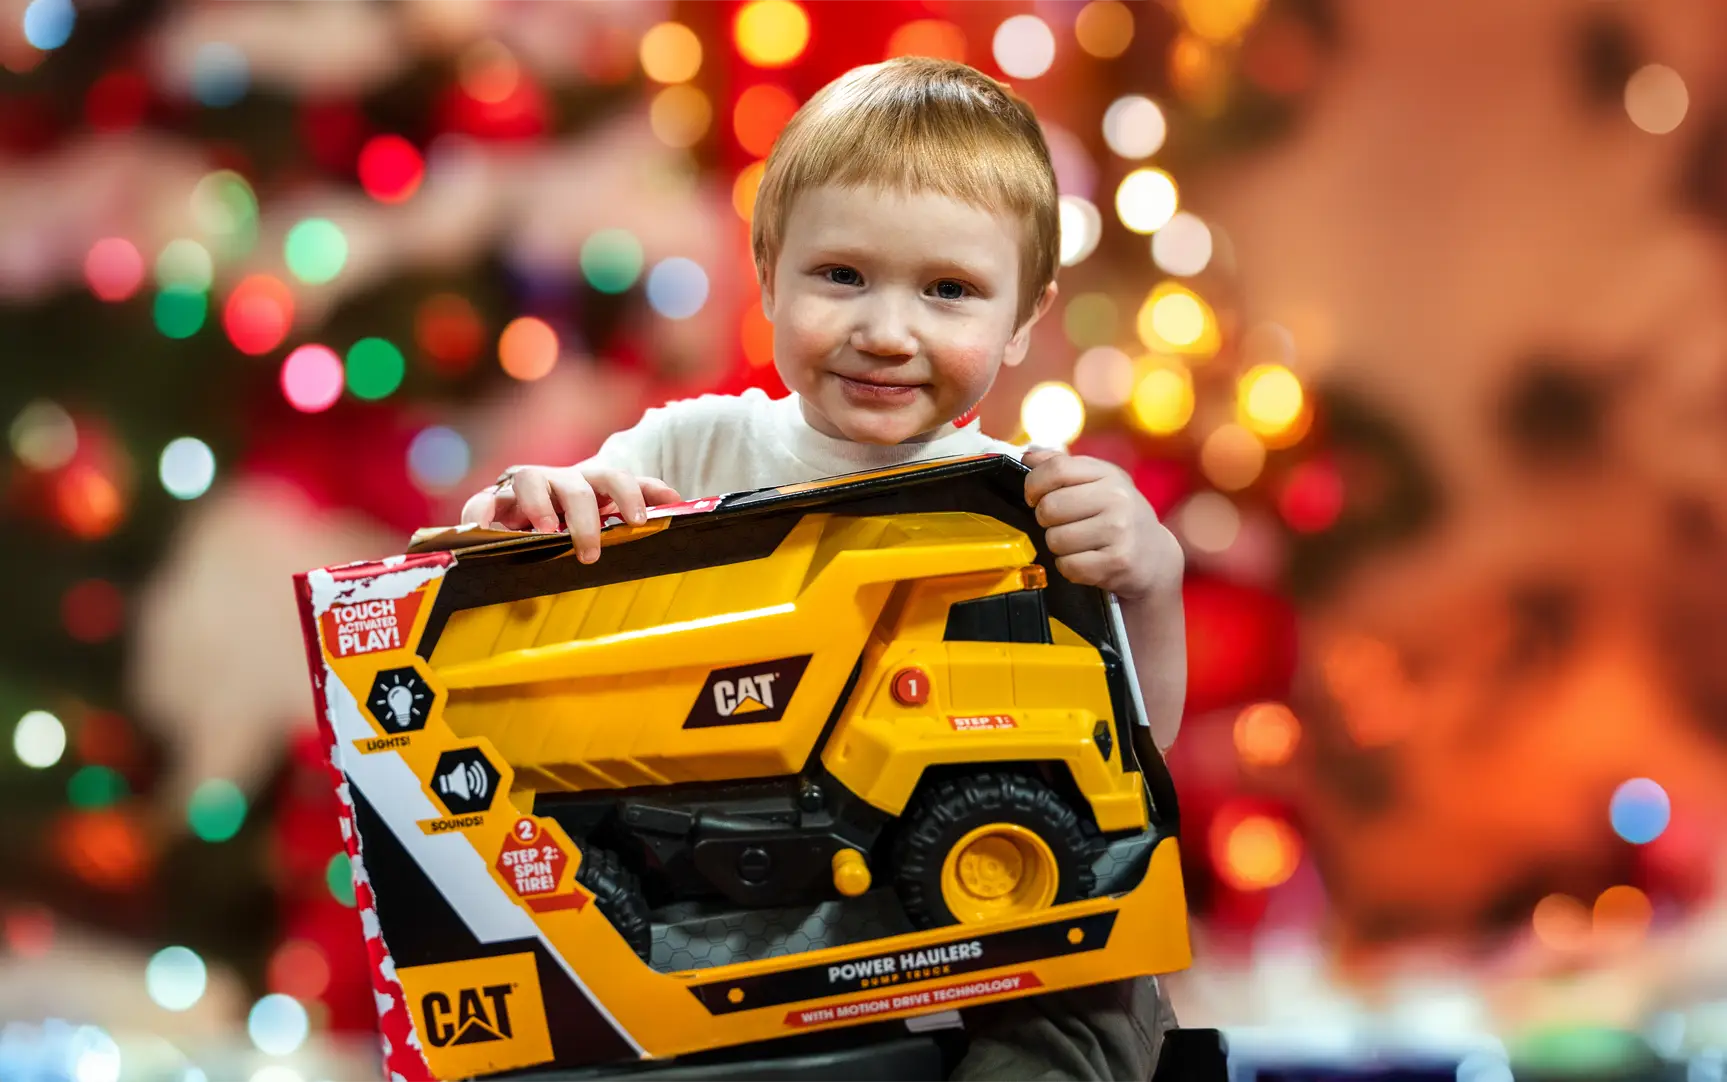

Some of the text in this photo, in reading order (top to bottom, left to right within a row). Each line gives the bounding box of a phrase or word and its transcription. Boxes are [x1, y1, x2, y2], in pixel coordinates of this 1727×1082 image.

[332, 600, 396, 624] TOUCH
[338, 616, 398, 634] ACTIVATED
[339, 627, 400, 655] PLAY!
[713, 673, 775, 716] CAT
[908, 679, 917, 697] 1
[954, 717, 989, 727] STEP
[366, 736, 411, 751] LIGHTS!
[430, 816, 484, 832] SOUNDS!
[519, 820, 534, 839] 2
[502, 846, 559, 866] STEP 2:
[514, 860, 552, 878] SPIN
[516, 875, 555, 893] TIRE!
[828, 941, 983, 982] POWER HAULERS
[861, 965, 951, 988] DUMP TRUCK
[801, 977, 1021, 1023] WITH MOTION DRIVE TECHNOLOGY
[421, 983, 513, 1048] CAT
